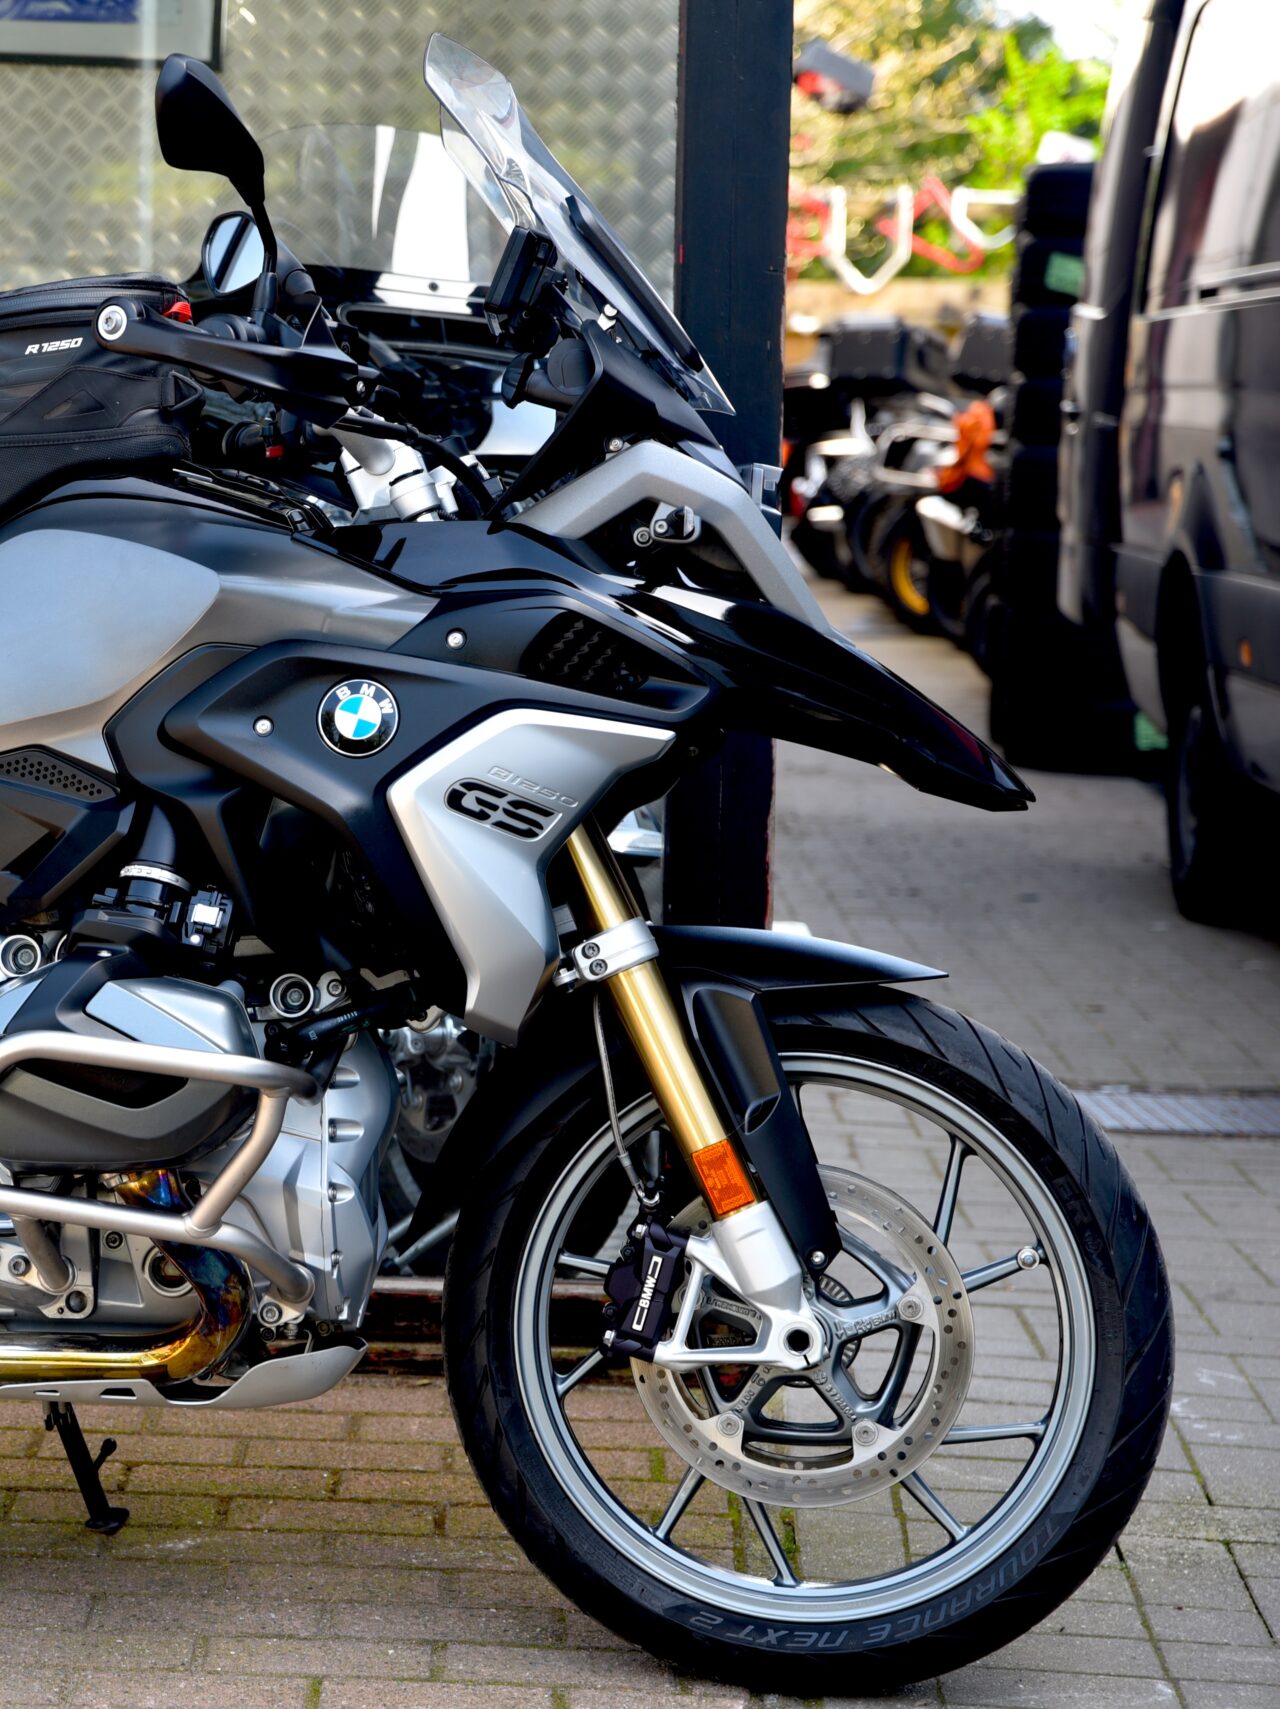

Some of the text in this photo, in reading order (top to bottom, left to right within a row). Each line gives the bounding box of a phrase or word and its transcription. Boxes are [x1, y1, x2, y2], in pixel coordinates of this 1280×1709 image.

[24, 337, 84, 356] R 1250
[335, 683, 394, 713] BMW
[446, 781, 556, 838] GS
[639, 1275, 657, 1309] BMW
[688, 1515, 1062, 1648] TOURANCE NEXT 2
